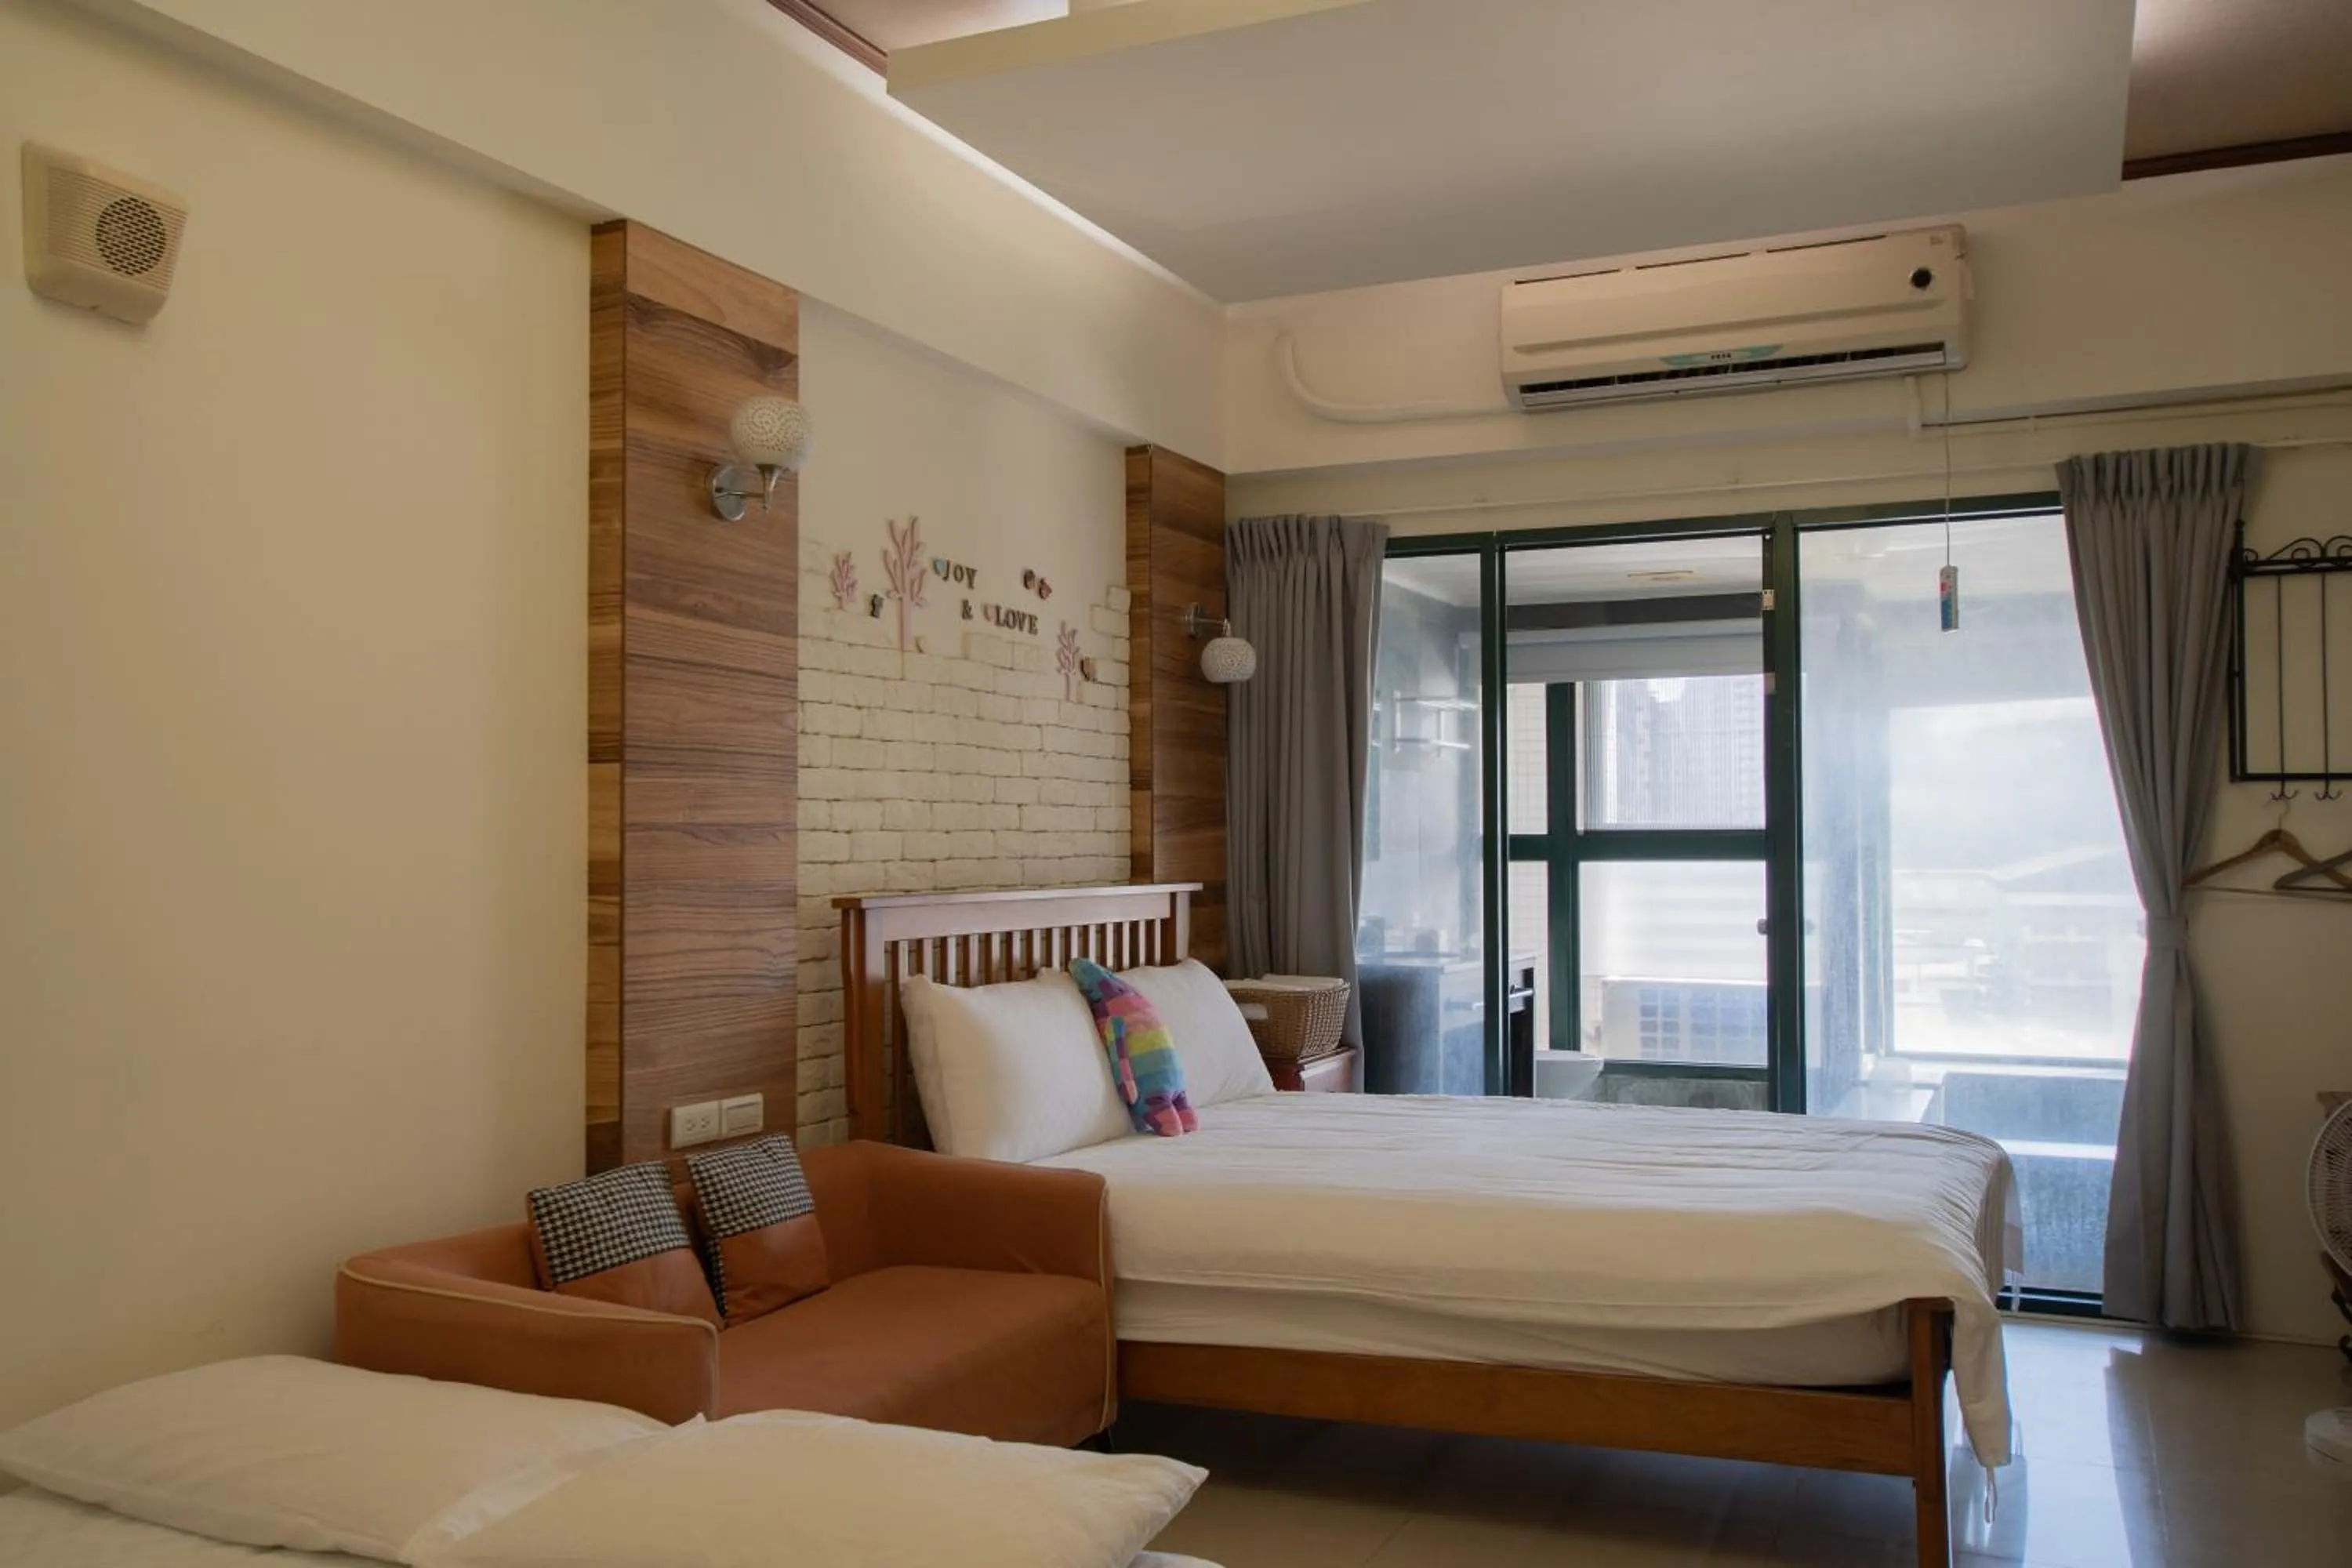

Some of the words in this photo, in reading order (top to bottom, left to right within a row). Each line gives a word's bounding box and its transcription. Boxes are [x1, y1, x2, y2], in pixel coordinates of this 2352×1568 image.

[942, 560, 978, 590] JOY
[961, 598, 974, 620] &
[994, 604, 1039, 636] LOVE
